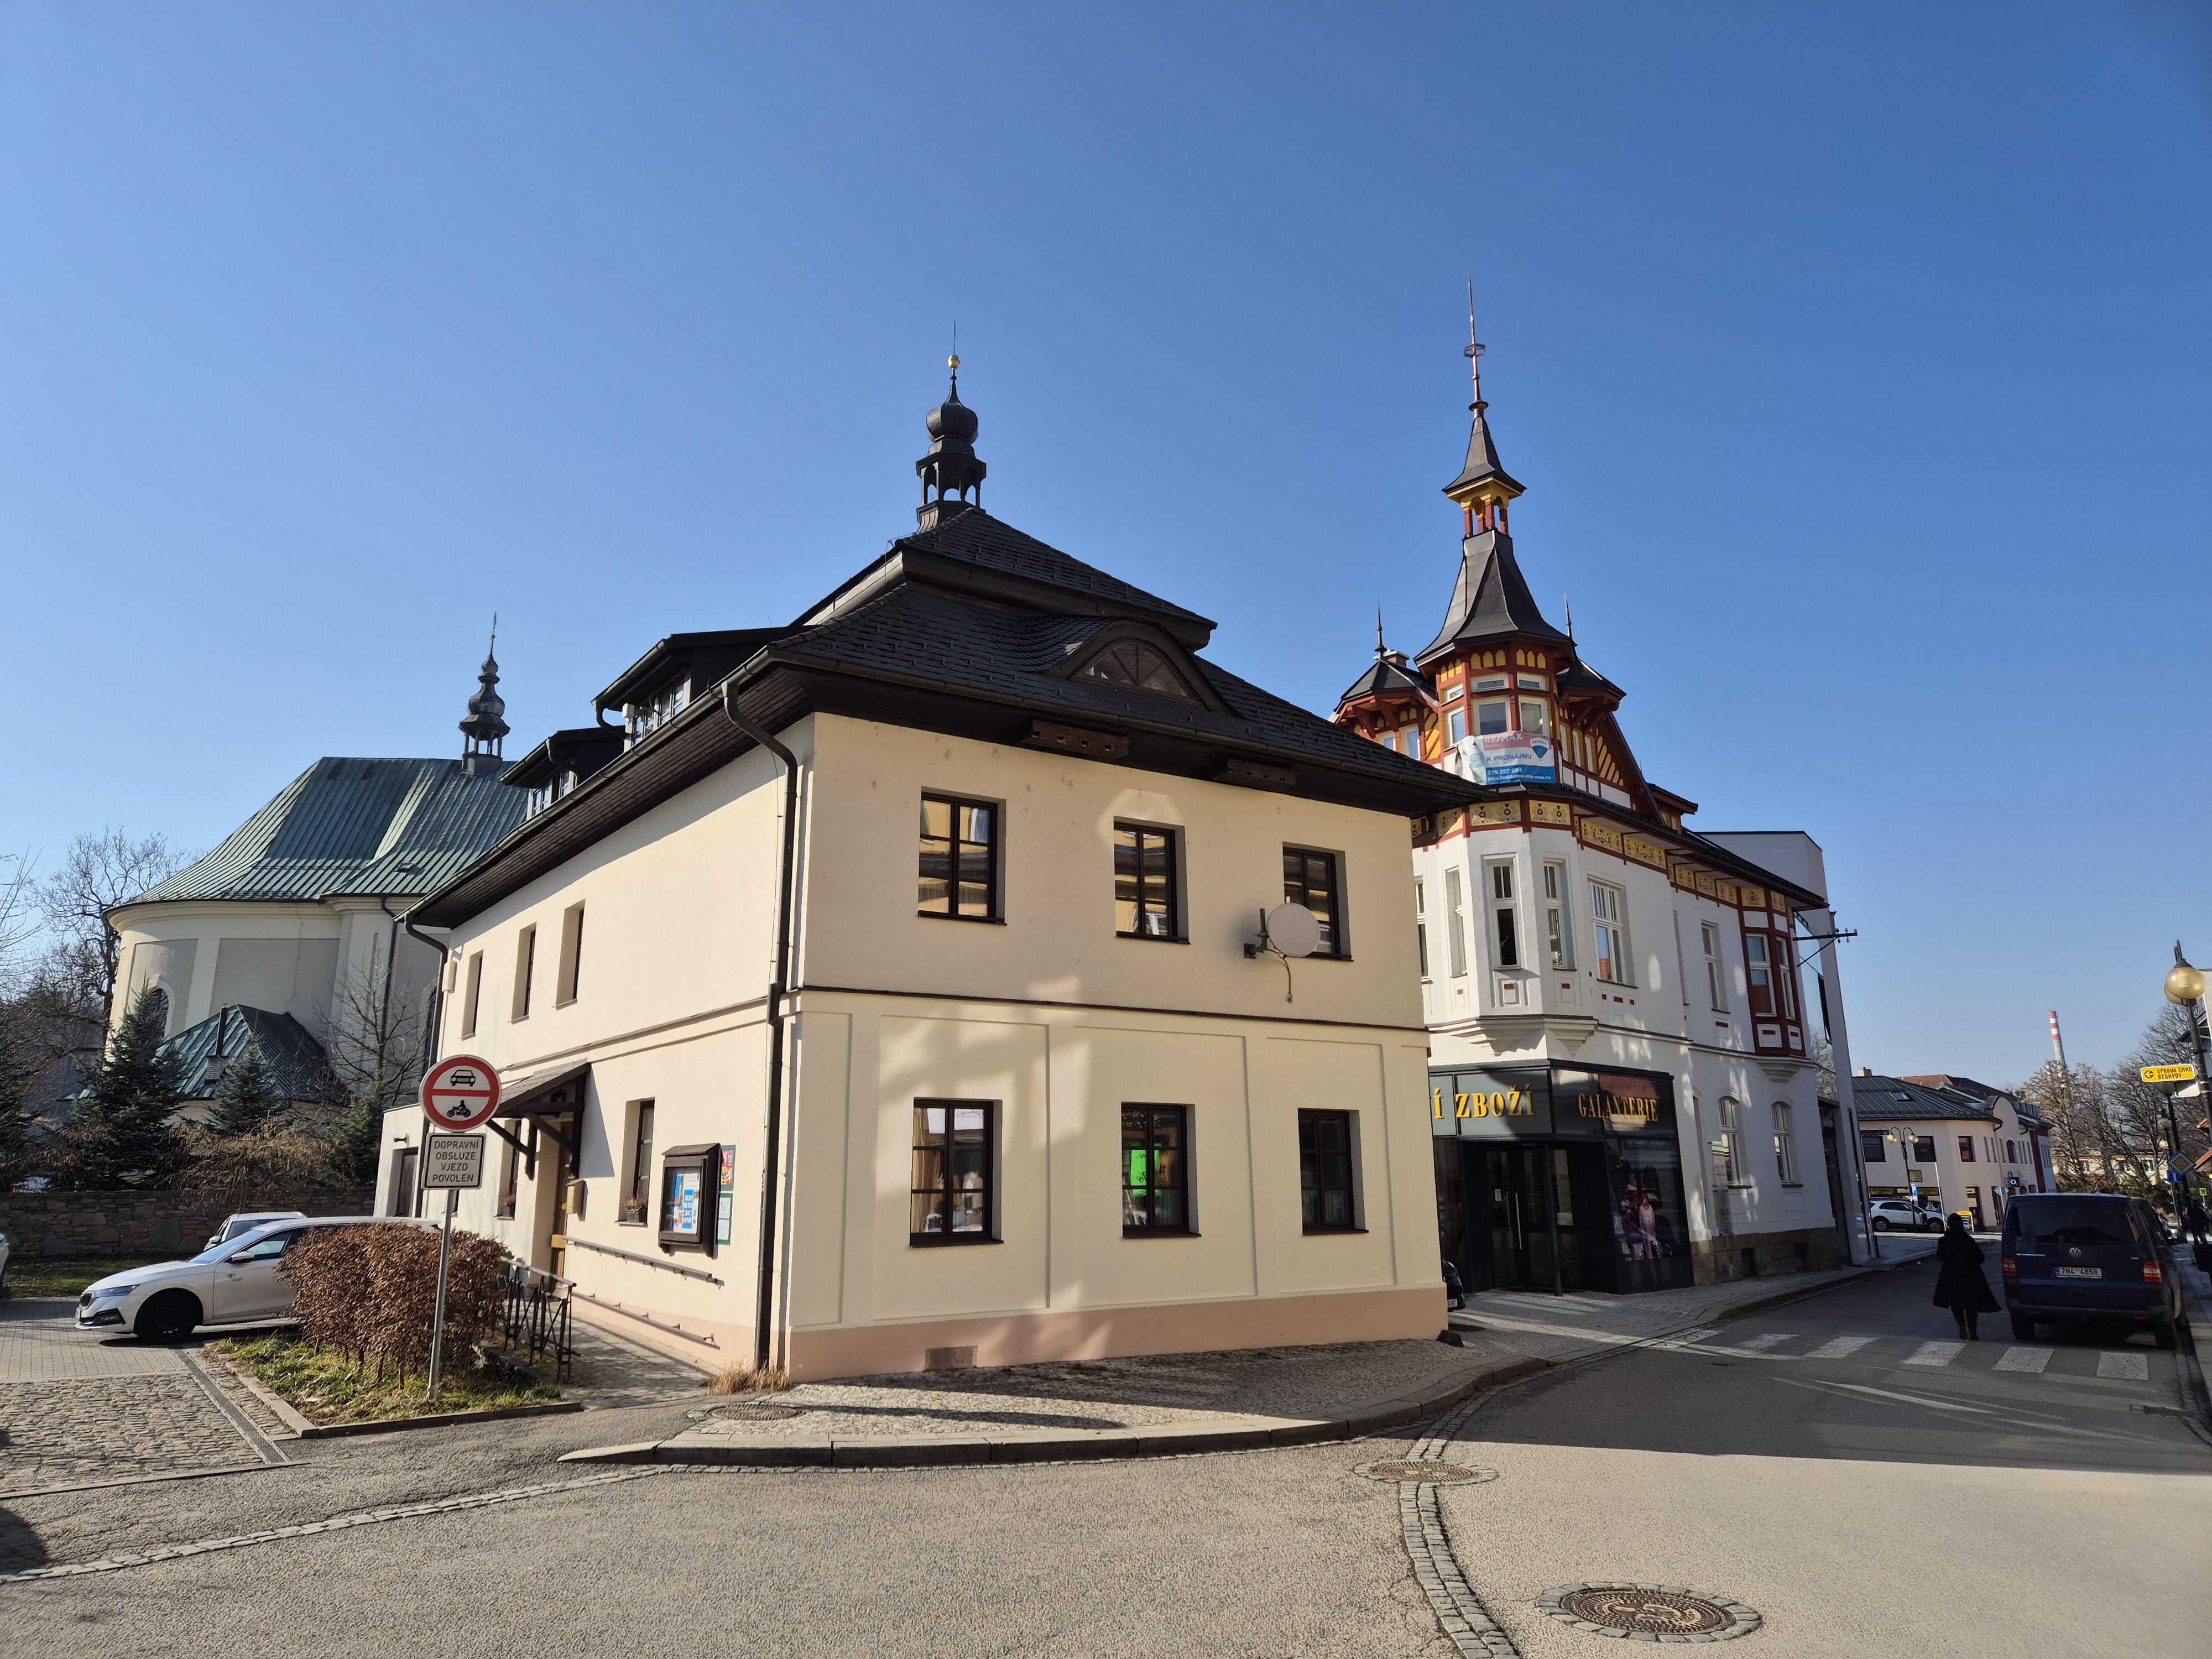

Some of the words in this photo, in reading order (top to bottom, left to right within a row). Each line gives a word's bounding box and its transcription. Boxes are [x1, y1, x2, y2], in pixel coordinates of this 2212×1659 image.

[1484, 733, 1522, 743] RE/MAX
[1455, 1084, 1535, 1118] ZBOŽÍ
[1578, 1092, 1658, 1121] GALANTERIE
[434, 1139, 479, 1149] DOPRAVNÍ
[436, 1152, 476, 1160] OBSLUZE
[441, 1163, 468, 1171] VJEZD
[432, 1173, 473, 1182] POVOLEN
